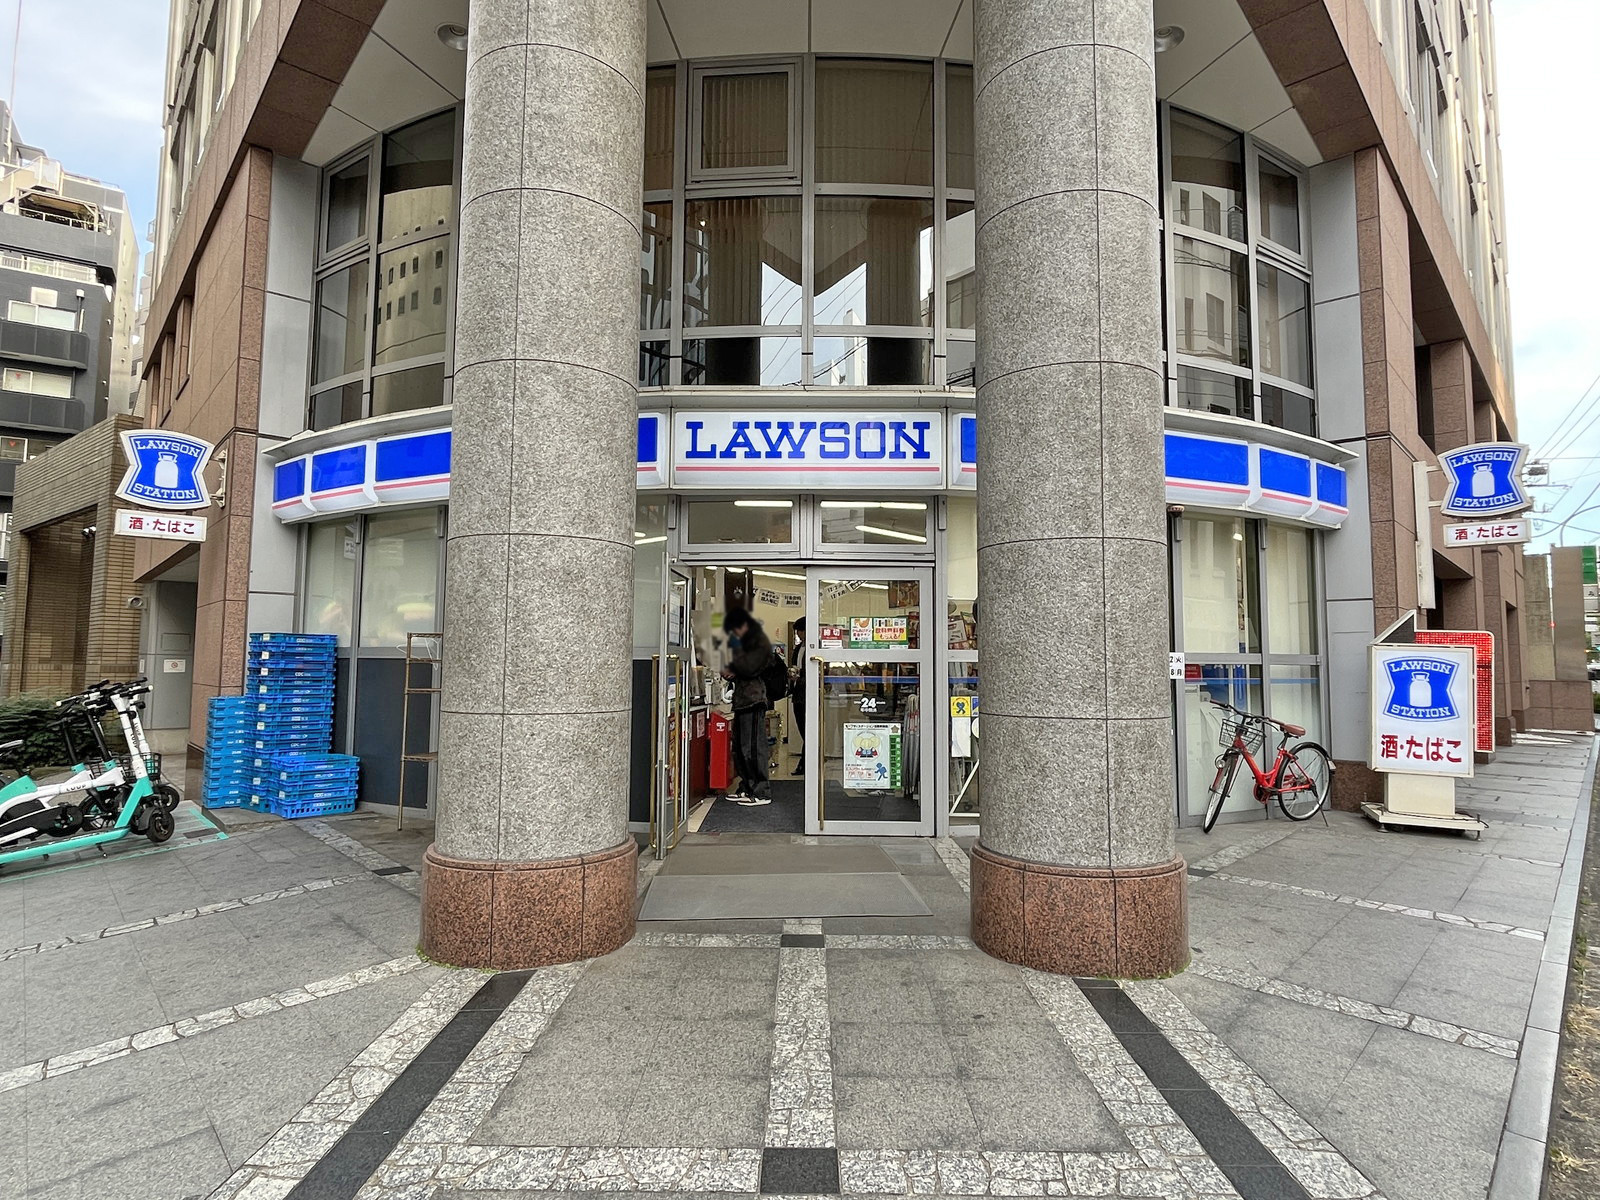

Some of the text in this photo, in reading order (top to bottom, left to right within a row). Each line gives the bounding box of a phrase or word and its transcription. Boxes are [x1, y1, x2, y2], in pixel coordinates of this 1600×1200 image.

[685, 421, 931, 459] LAWSON
[135, 440, 201, 458] LAWSON
[1451, 451, 1515, 467] LAWSON
[133, 483, 197, 499] STATION
[1453, 492, 1515, 507] STATION
[128, 516, 195, 535] 酒・たばこ
[1454, 525, 1519, 540] 酒・たばこ
[1390, 661, 1452, 675] LAWSON
[860, 697, 877, 708] 24
[1391, 704, 1451, 718] STATION
[1380, 734, 1462, 763] 酒・たばこ
